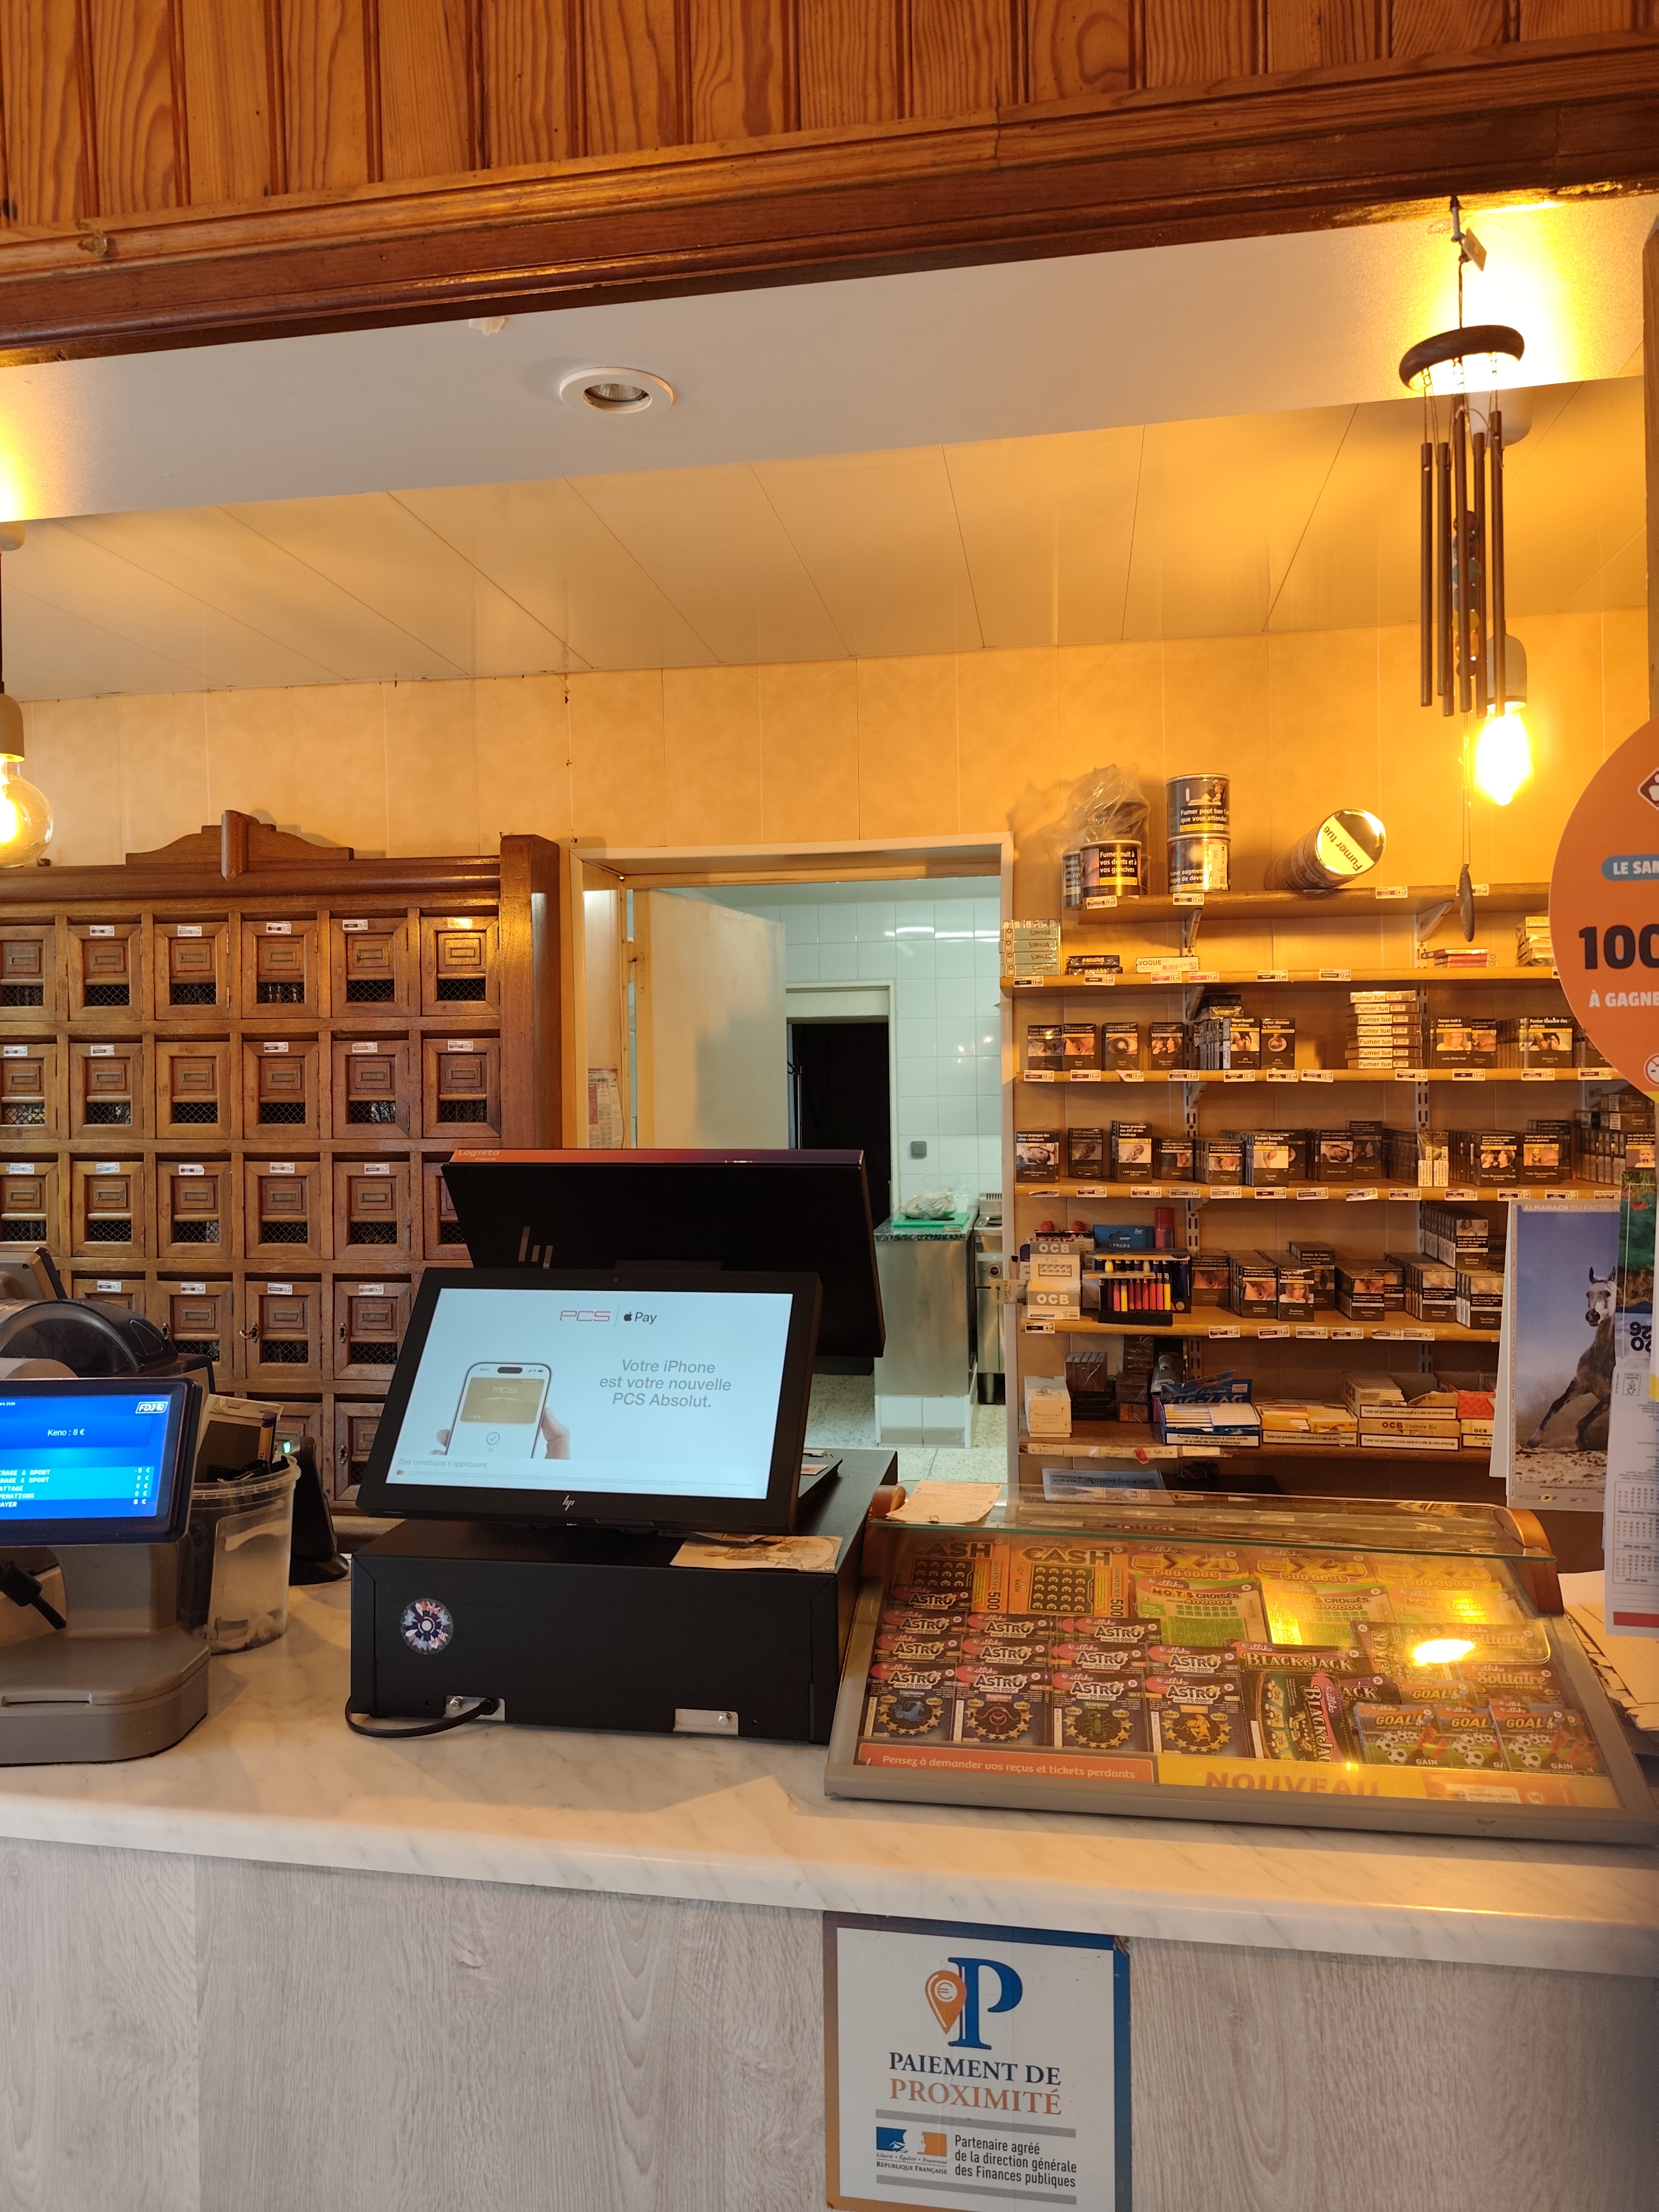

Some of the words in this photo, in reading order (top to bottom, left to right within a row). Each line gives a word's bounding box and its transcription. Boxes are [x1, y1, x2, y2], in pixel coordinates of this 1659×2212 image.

[1323, 826, 1337, 843] tue
[1336, 843, 1362, 871] Fumer
[1613, 862, 1628, 875] LE
[1589, 990, 1600, 1007] À
[1039, 1243, 1070, 1253] OCB
[1037, 1294, 1069, 1304] OCB
[560, 1310, 611, 1322] PCS
[634, 1311, 657, 1325] Pay
[621, 1359, 660, 1373] Votre
[663, 1359, 716, 1374] iPhone
[600, 1377, 623, 1390] est
[627, 1377, 664, 1390] votre
[668, 1377, 731, 1391] nouvelle
[612, 1392, 646, 1407] PCS
[649, 1393, 712, 1408] Absolut.
[909, 1593, 956, 1606] ASTRO
[987, 1592, 1000, 1610] 500
[1152, 1587, 1194, 1599] MOTS
[1196, 1592, 1240, 1600] CROISÉS
[1110, 1599, 1123, 1617] 500
[900, 1617, 949, 1631] ASTRO
[985, 1621, 1034, 1634] ASTRO
[893, 1642, 944, 1655] ASTRO
[980, 1646, 1032, 1660] ASTRO
[1249, 1643, 1272, 1651] illiko
[1076, 1651, 1128, 1666] ASTRO
[1169, 1654, 1221, 1669] ASTRO
[888, 1670, 941, 1684] ASTRO
[974, 1674, 1027, 1688] ASTRO
[1476, 1671, 1547, 1686] Solitaire
[1070, 1681, 1124, 1696] ASTRO
[1166, 1685, 1220, 1700] ASTRO
[883, 1756, 917, 1767] Pensez
[920, 1756, 927, 1765] à
[929, 1758, 983, 1770] demander
[1006, 1765, 1034, 1774] reçus
[1049, 1764, 1084, 1776] tickets
[1088, 1768, 1135, 1779] perdants
[1205, 1771, 1379, 1796] NOUVEAU
[948, 1957, 1023, 2050] P
[889, 2052, 1018, 2081] PAIEMENT
[1025, 2065, 1061, 2086] DE
[890, 2078, 1062, 2115] PROXIMITÉ
[955, 2134, 1008, 2152] Partenaire
[1011, 2142, 1040, 2157] agréé
[877, 2162, 913, 2171] RÉPUBLIQUE
[915, 2165, 947, 2174] FRANÇAISE
[955, 2150, 968, 2163] de
[970, 2151, 980, 2163] la
[983, 2152, 1029, 2168] direction
[1031, 2156, 1077, 2173] générale
[955, 2163, 973, 2177] des
[976, 2165, 1022, 2182] Finances
[1025, 2170, 1076, 2189] publiques
